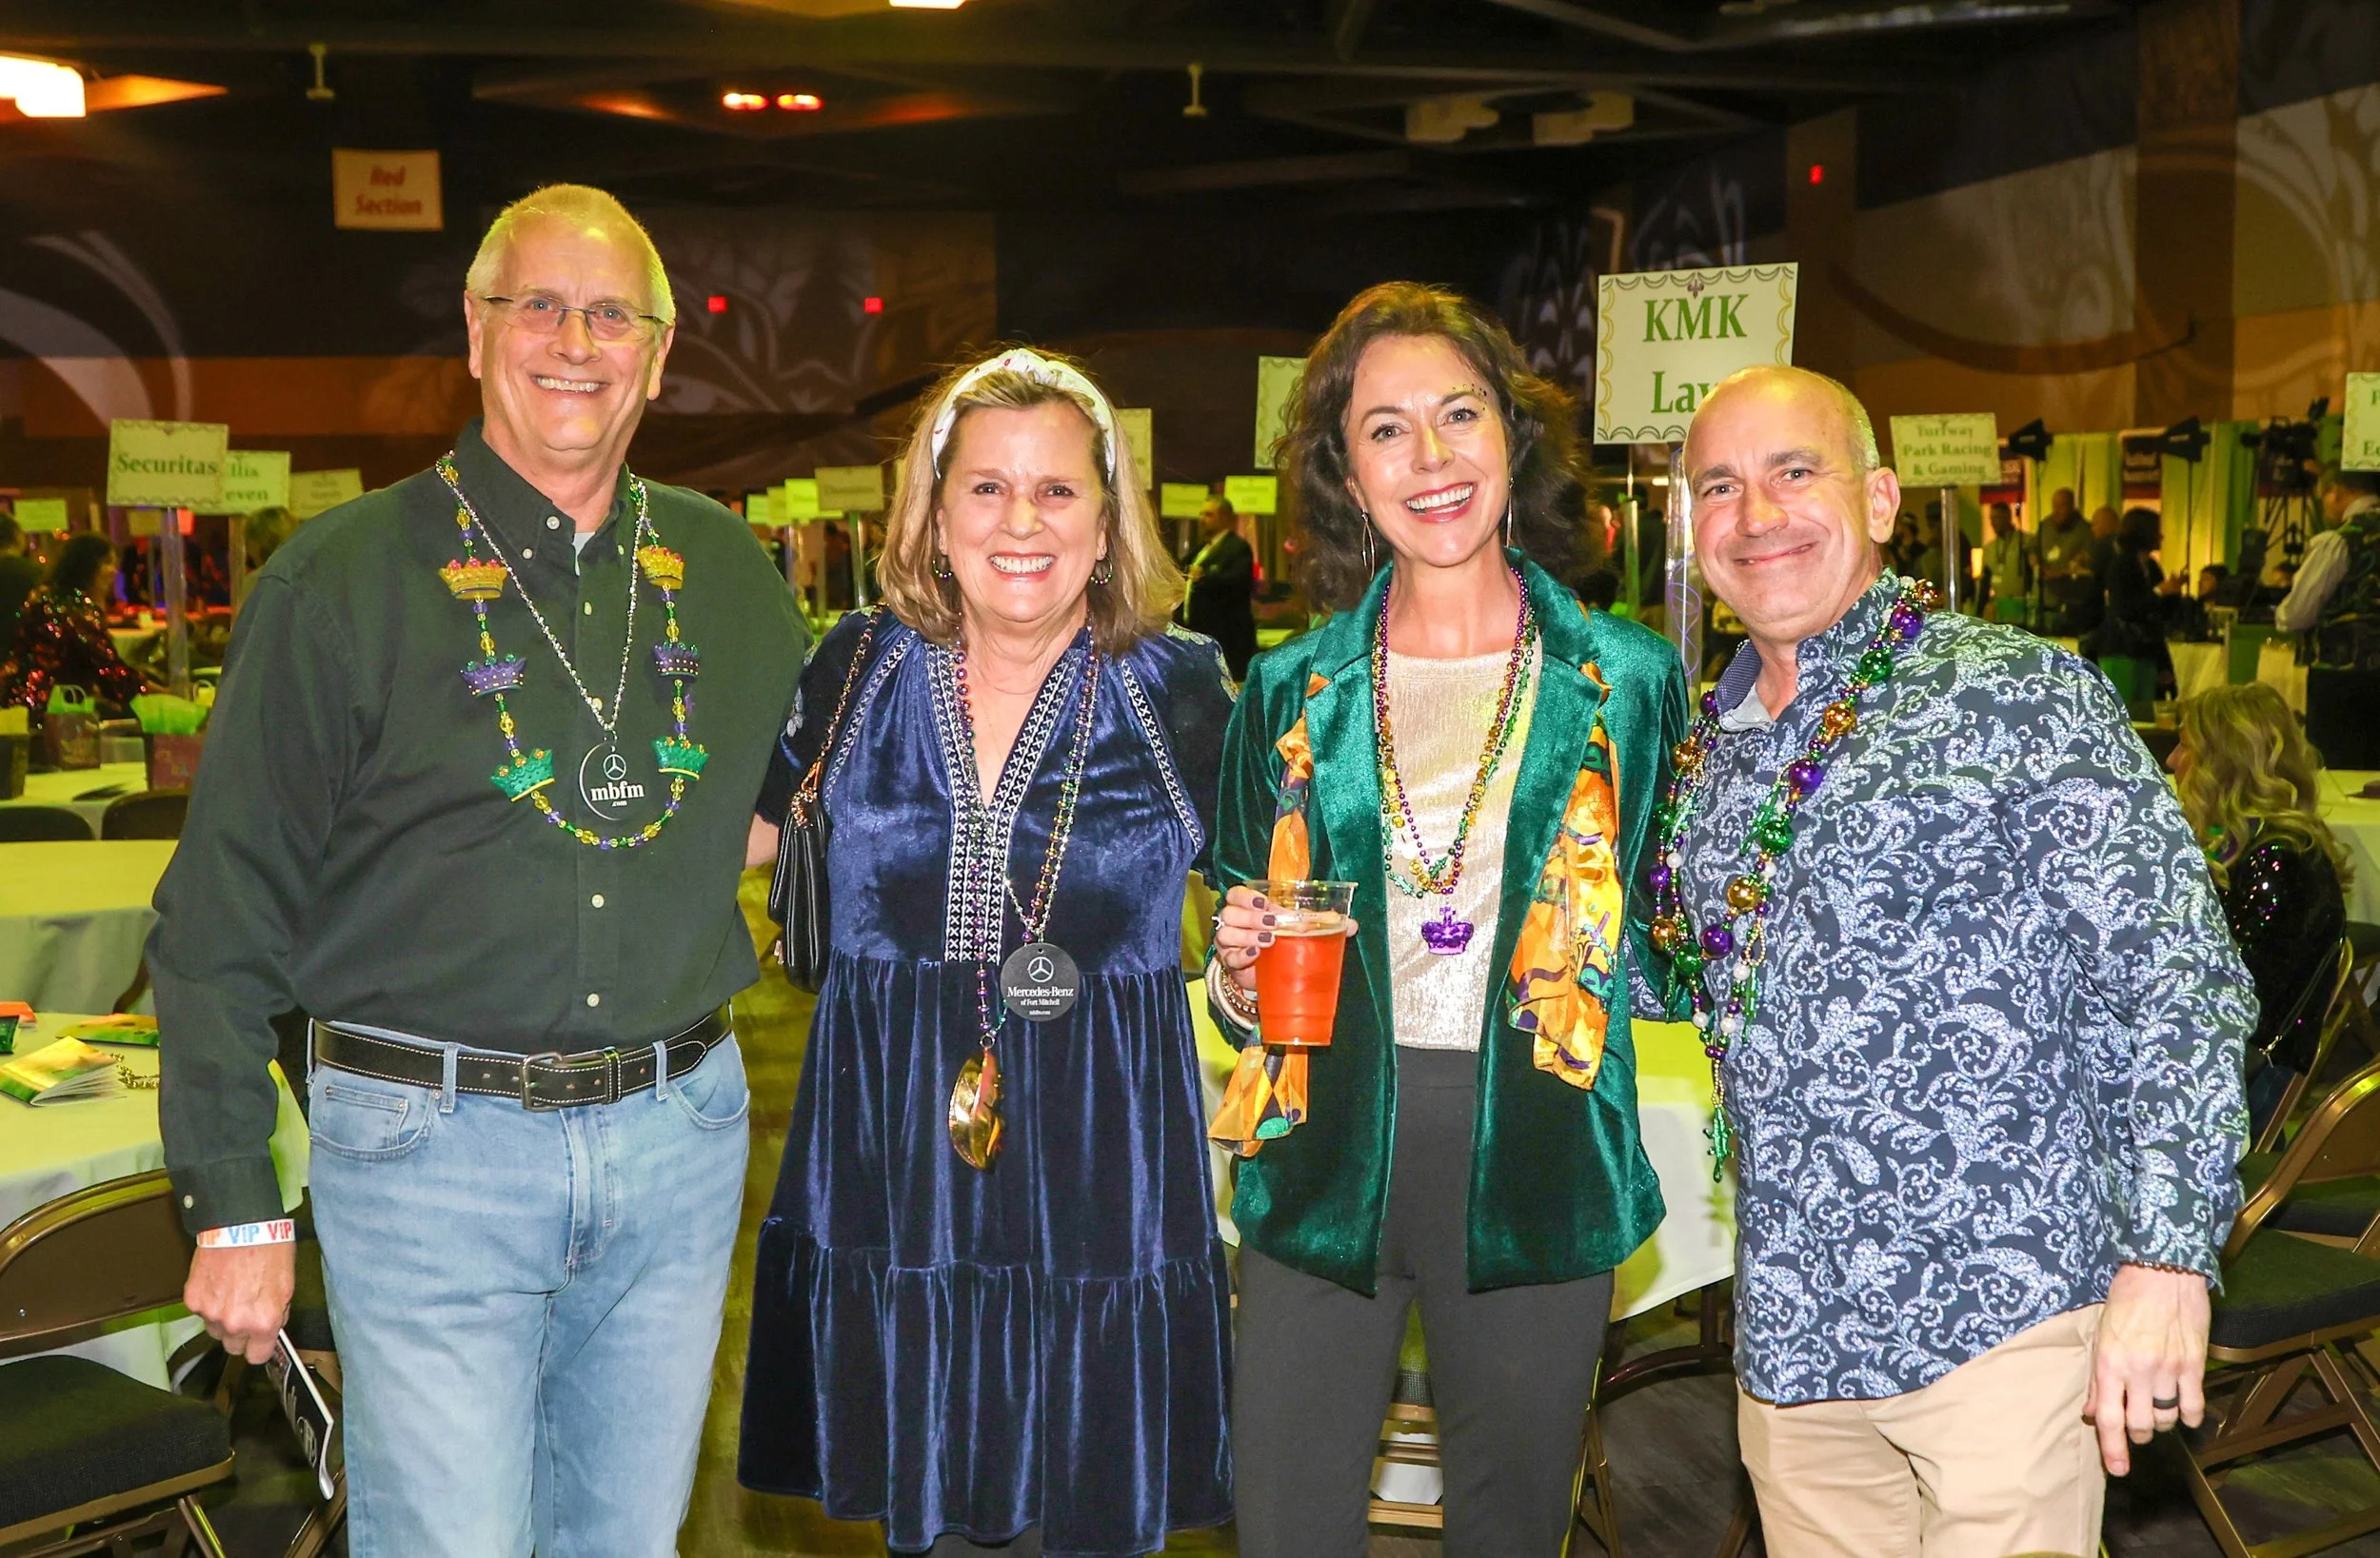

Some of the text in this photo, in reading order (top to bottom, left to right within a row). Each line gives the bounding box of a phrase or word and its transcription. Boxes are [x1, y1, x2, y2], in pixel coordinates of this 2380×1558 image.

[370, 166, 407, 187] Red
[355, 193, 423, 216] Section
[1642, 294, 1750, 342] KMK
[1903, 442, 1992, 457] Park Racing
[117, 454, 219, 474] Securitas
[229, 462, 259, 477] llis
[1929, 462, 1986, 479] Gaming
[225, 489, 268, 501] even
[590, 780, 645, 801] mbfm
[1007, 986, 1074, 997] Mercedes-Benz
[228, 1224, 260, 1244] VIP
[268, 1221, 291, 1240] VIP
